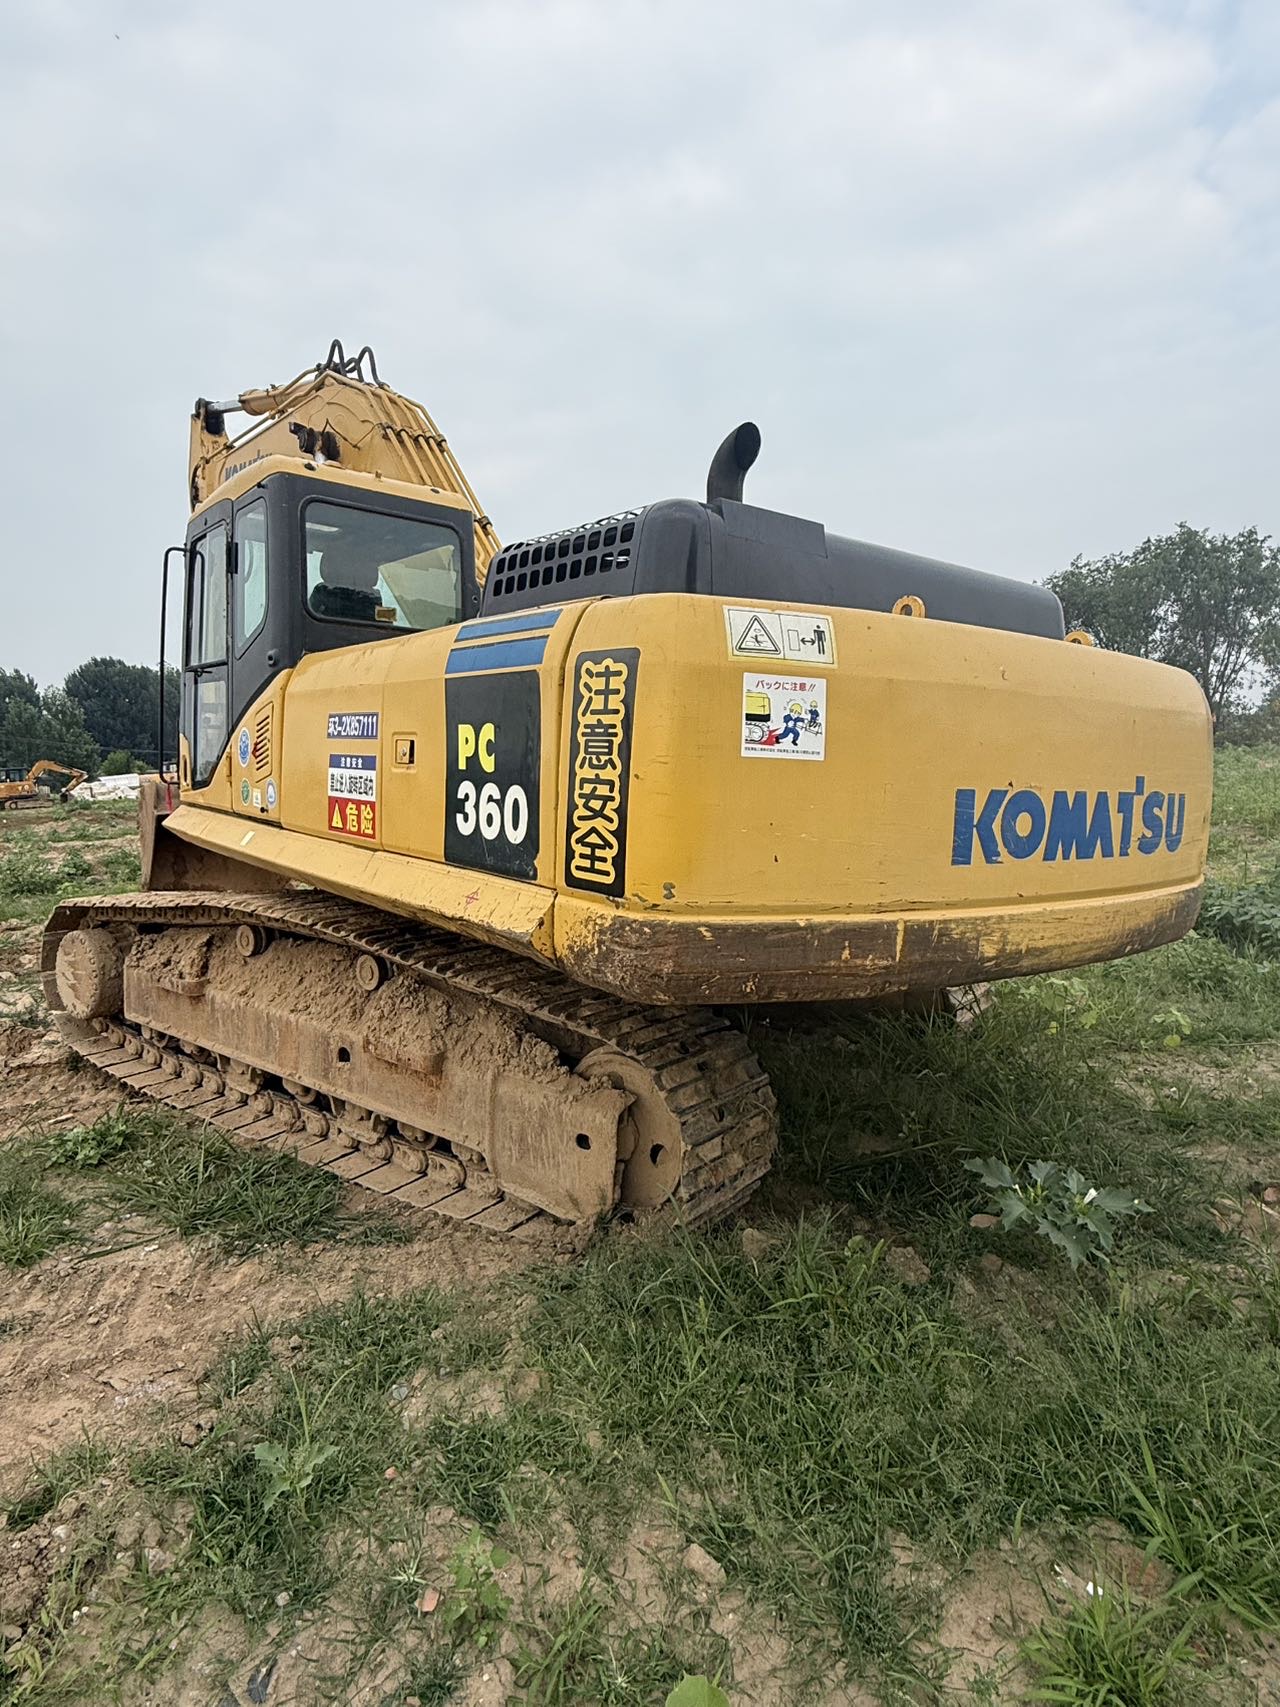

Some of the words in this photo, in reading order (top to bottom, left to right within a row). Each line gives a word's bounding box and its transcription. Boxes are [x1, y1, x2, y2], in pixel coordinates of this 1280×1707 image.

[457, 722, 496, 773] PC
[571, 657, 628, 885] 注意安全
[345, 801, 374, 835] 危险
[456, 780, 529, 845] 360
[951, 775, 1186, 866] KOMATSU
